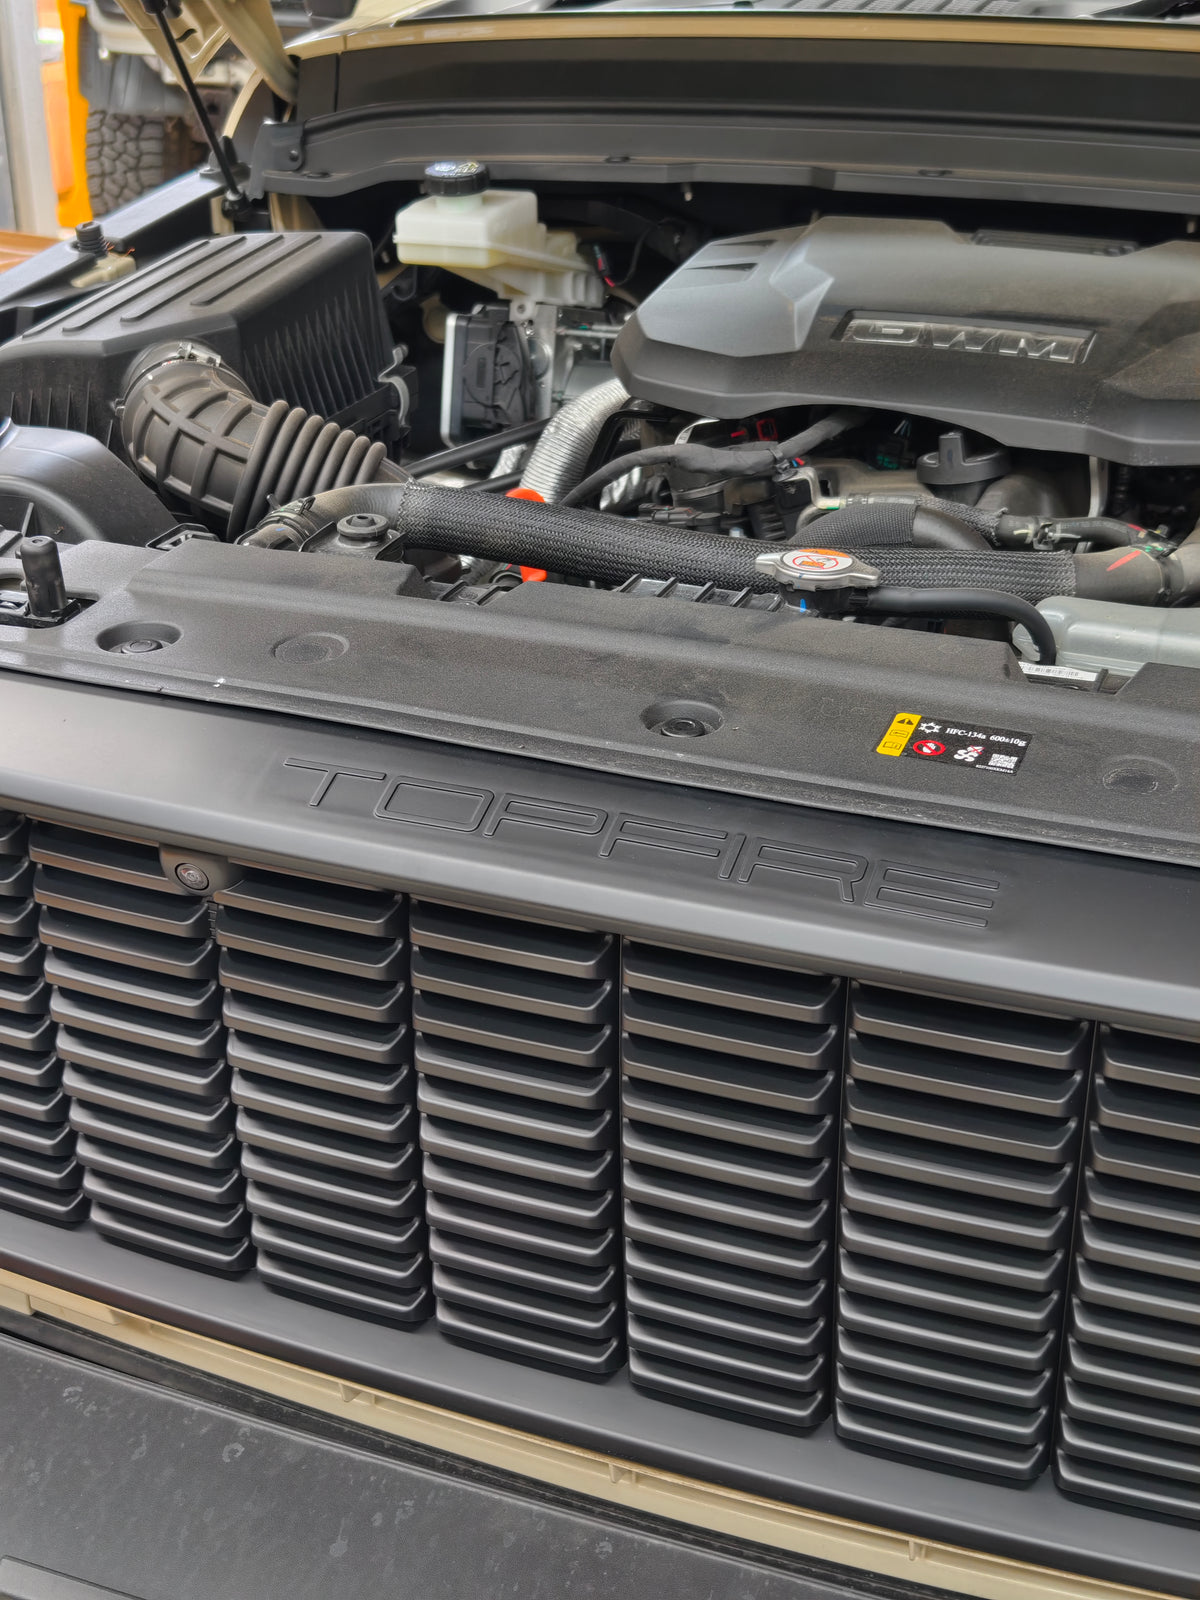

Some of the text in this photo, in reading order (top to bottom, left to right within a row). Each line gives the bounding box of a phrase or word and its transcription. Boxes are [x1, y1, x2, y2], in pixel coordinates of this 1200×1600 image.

[847, 319, 1077, 363] GWM
[945, 728, 1027, 746] HFC-134a 600±10g
[283, 757, 1000, 928] TOPFIRE
